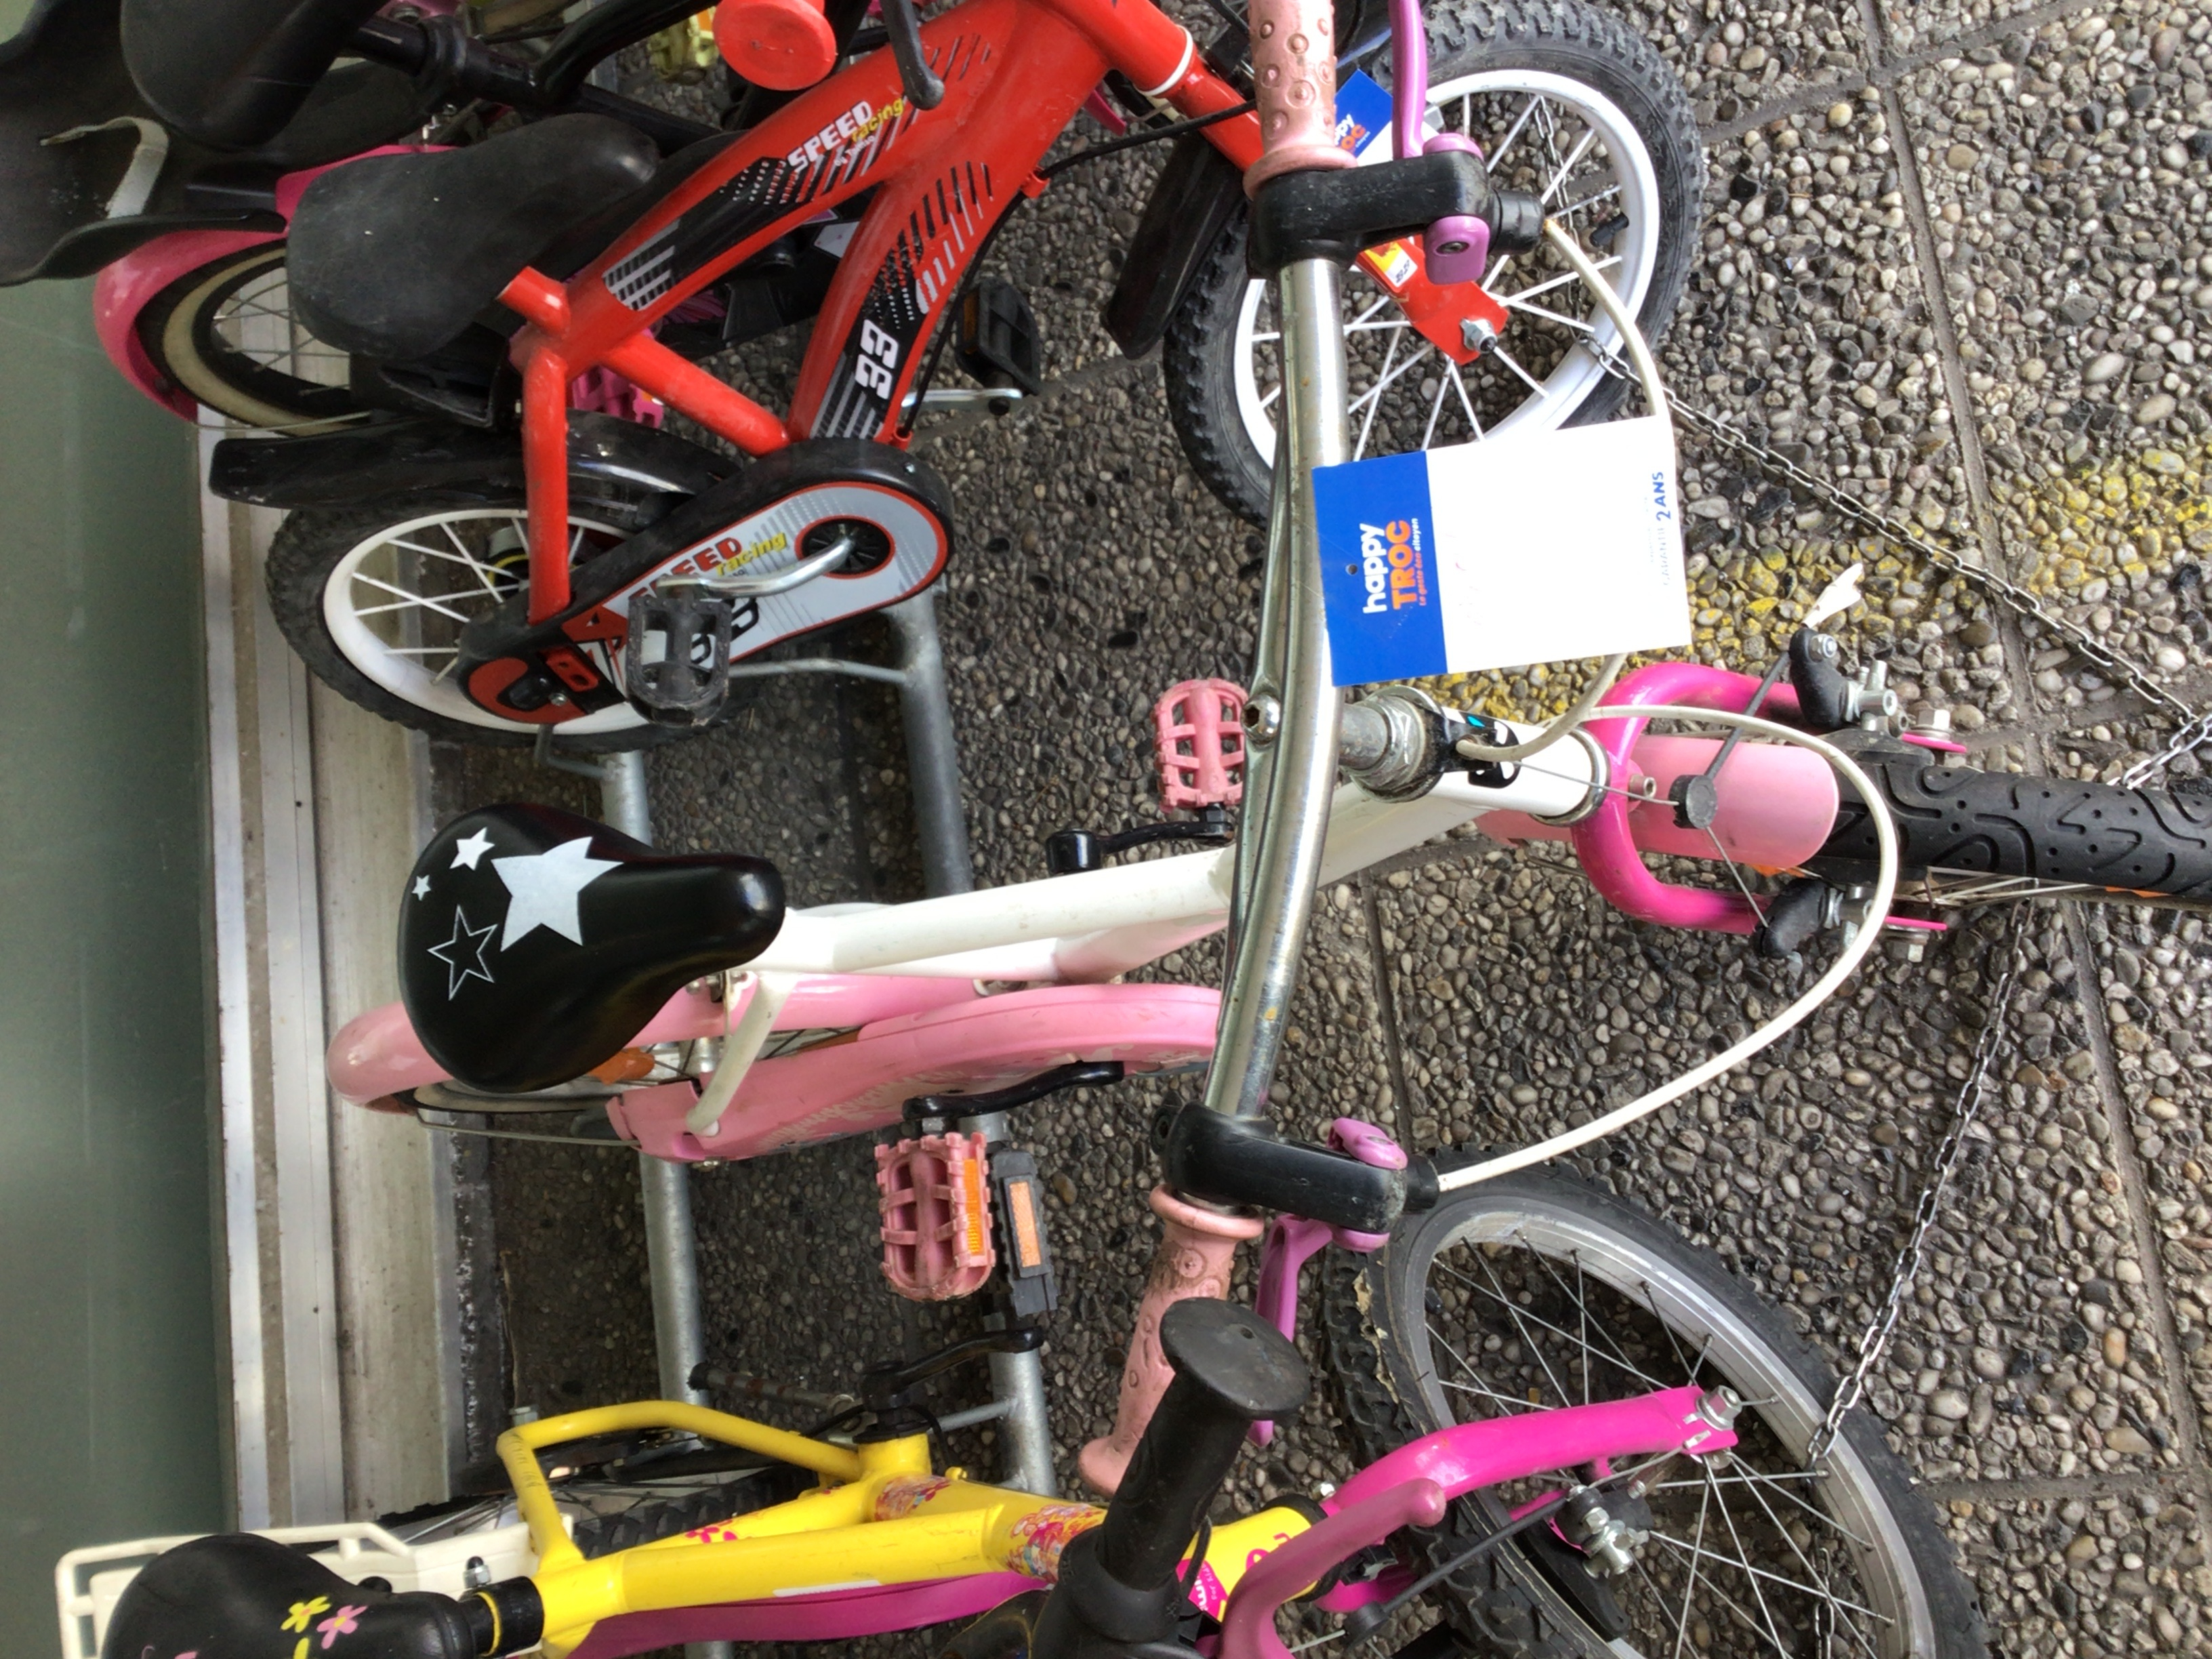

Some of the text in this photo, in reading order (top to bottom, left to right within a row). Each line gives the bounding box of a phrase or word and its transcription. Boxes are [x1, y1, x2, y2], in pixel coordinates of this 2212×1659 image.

[787, 100, 872, 173] SPEED
[852, 98, 904, 142] racing
[1341, 124, 1366, 150] OC
[855, 319, 899, 400] 33
[1652, 471, 1667, 508] ANS
[1411, 517, 1422, 552] citoyen
[1655, 510, 1672, 522] 2
[716, 531, 788, 577] racing
[1359, 523, 1389, 614] happy
[1385, 520, 1418, 611] TROC
